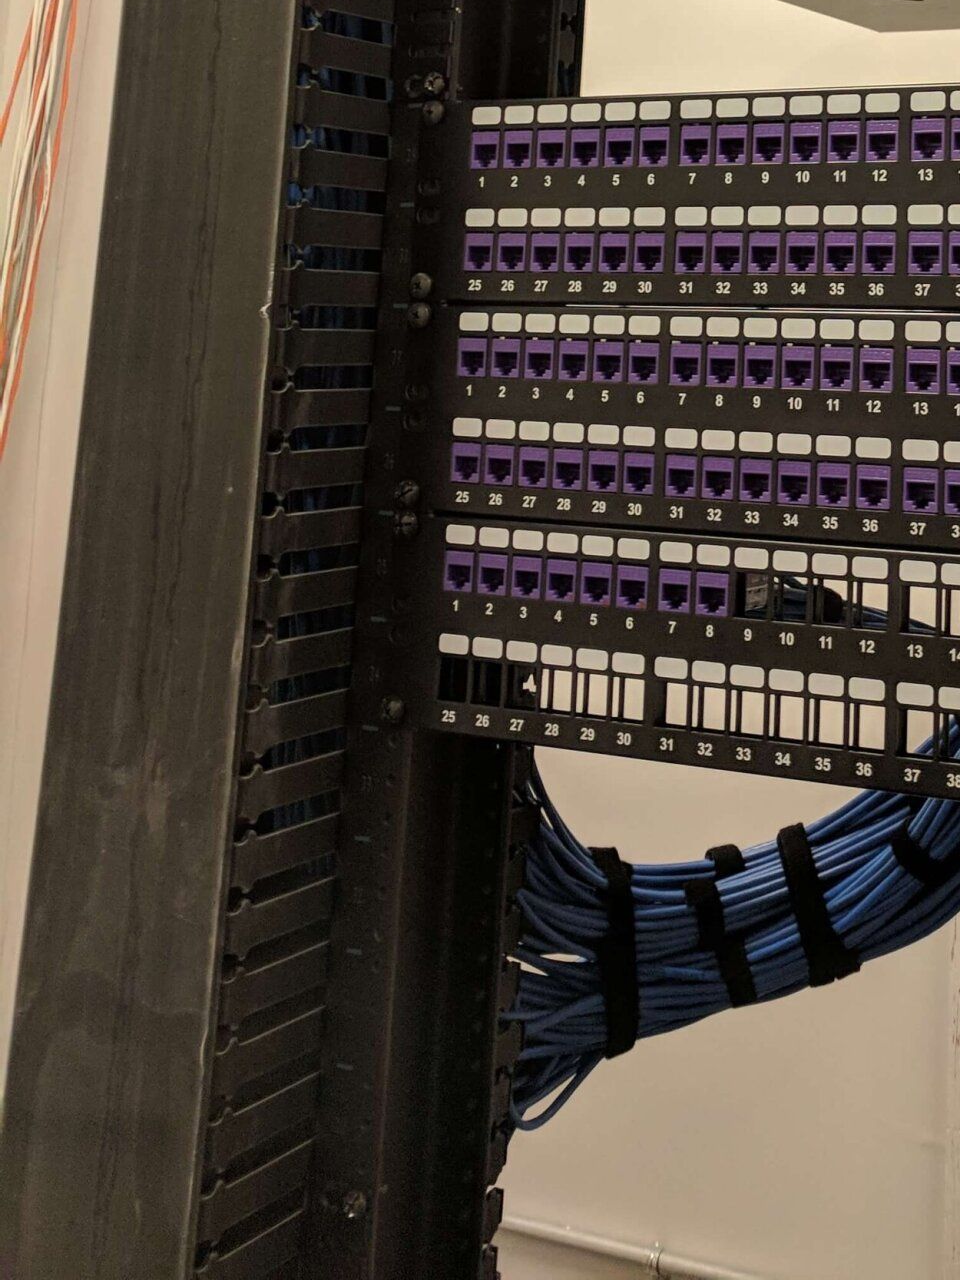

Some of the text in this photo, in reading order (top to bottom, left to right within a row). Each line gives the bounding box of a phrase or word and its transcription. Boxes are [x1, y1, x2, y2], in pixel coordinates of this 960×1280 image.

[478, 176, 485, 188] 1
[510, 175, 519, 188] 2
[543, 175, 552, 187] 3
[577, 174, 586, 187] 4
[611, 173, 620, 186] 5
[647, 173, 655, 186] 6
[688, 172, 697, 185] 7
[724, 171, 733, 185] 8
[761, 171, 770, 184] 9
[795, 170, 811, 183] 10
[833, 169, 847, 183] 11
[871, 169, 888, 182] 12
[917, 168, 934, 182] 13
[467, 279, 482, 292] 25
[500, 279, 515, 292] 26
[533, 279, 549, 292] 27
[567, 280, 583, 293] 28
[602, 280, 617, 293] 29
[637, 280, 653, 294] 30
[678, 281, 693, 294] 31
[715, 281, 731, 294] 32
[752, 281, 768, 295] 33
[790, 282, 807, 295] 34
[829, 282, 845, 296] 35
[868, 282, 884, 296] 36
[914, 283, 931, 297] 37
[465, 384, 472, 397] 1
[498, 385, 507, 398] 2
[532, 386, 540, 400] 3
[565, 388, 574, 401] 4
[601, 389, 610, 403] 5
[636, 391, 645, 404] 6
[678, 392, 687, 406] 7
[715, 394, 724, 407] 8
[752, 395, 761, 409] 9
[787, 396, 803, 410] 10
[826, 398, 840, 412] 11
[865, 399, 882, 413] 12
[912, 401, 929, 416] 13
[455, 490, 470, 504] 25
[488, 492, 503, 506] 26
[522, 495, 537, 509] 27
[556, 497, 571, 511] 28
[591, 500, 607, 514] 29
[627, 502, 643, 516] 30
[669, 505, 684, 519] 31
[706, 508, 722, 522] 32
[744, 510, 760, 525] 33
[782, 513, 799, 527] 34
[822, 515, 839, 530] 35
[862, 518, 879, 533] 36
[909, 521, 927, 536] 37
[452, 599, 459, 612] 1
[485, 602, 494, 616] 2
[519, 606, 528, 619] 3
[553, 609, 563, 623] 4
[589, 613, 598, 626] 5
[625, 616, 634, 630] 6
[668, 620, 677, 634] 7
[705, 624, 714, 638] 8
[743, 628, 753, 642] 9
[778, 631, 795, 646] 10
[818, 635, 833, 650] 11
[859, 639, 876, 654] 12
[906, 643, 924, 659] 13
[441, 709, 456, 723] 25
[474, 713, 490, 728] 26
[509, 718, 525, 732] 27
[544, 722, 560, 737] 28
[579, 727, 596, 741] 29
[616, 731, 632, 746] 30
[659, 737, 674, 752] 31
[697, 741, 713, 757] 32
[735, 746, 752, 762] 33
[774, 751, 792, 767] 34
[814, 756, 832, 772] 35
[855, 761, 873, 777] 36
[903, 767, 922, 783] 37
